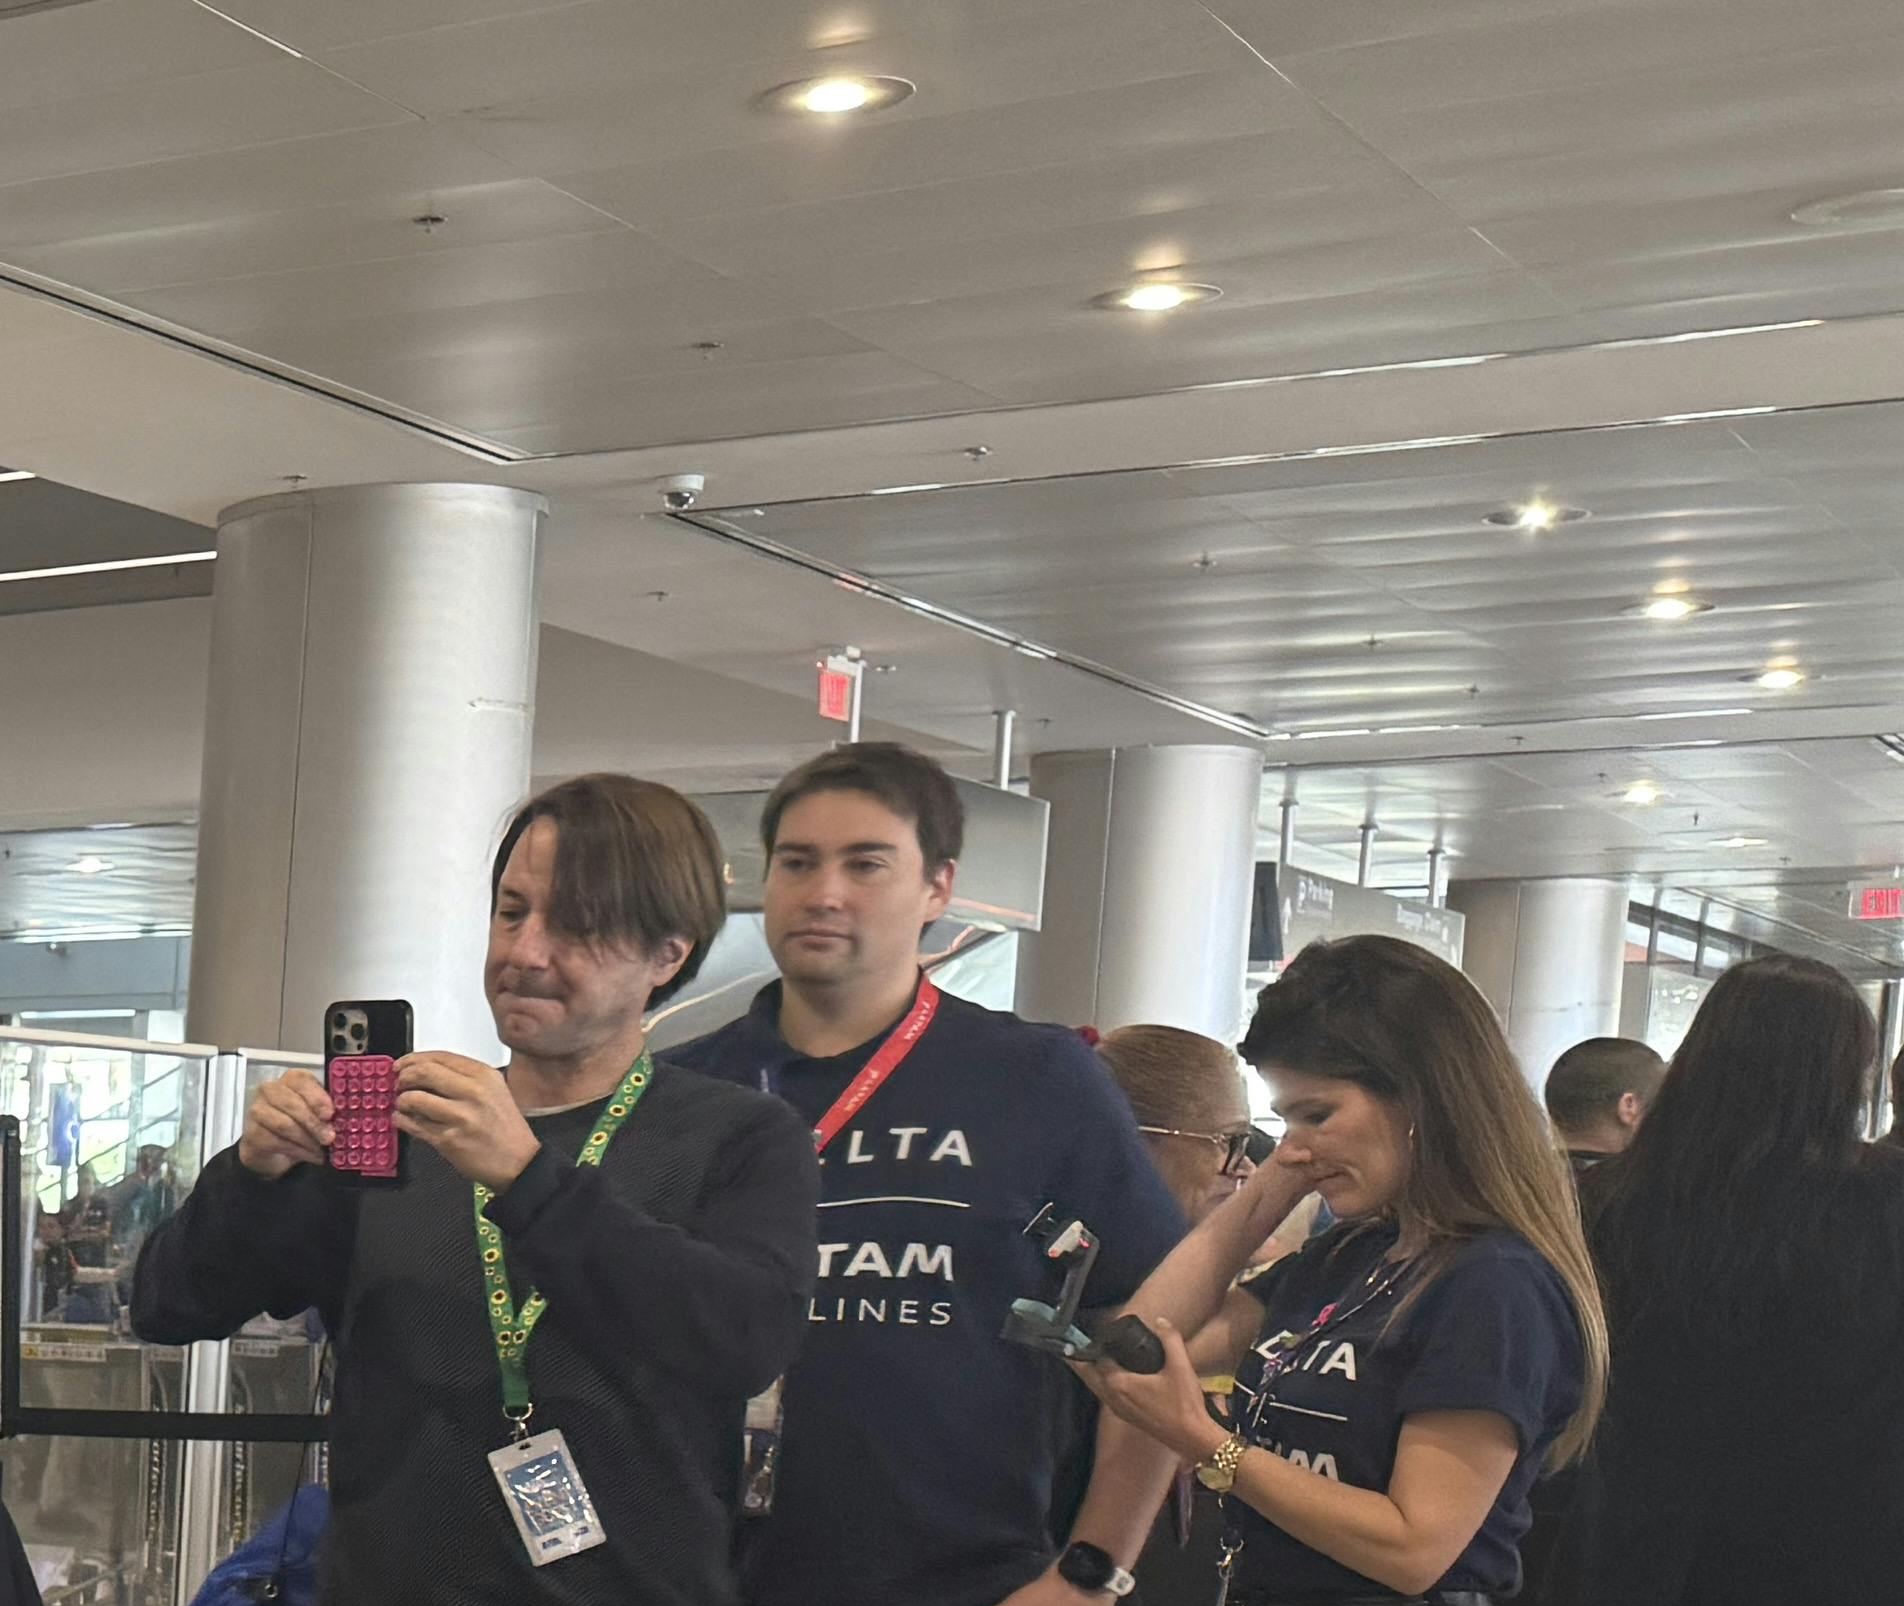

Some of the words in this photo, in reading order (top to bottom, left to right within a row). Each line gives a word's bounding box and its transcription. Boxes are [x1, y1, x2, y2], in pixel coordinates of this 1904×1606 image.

[813, 1127, 973, 1167] LTA
[817, 1241, 954, 1282] TAM
[808, 1297, 952, 1326] LINES
